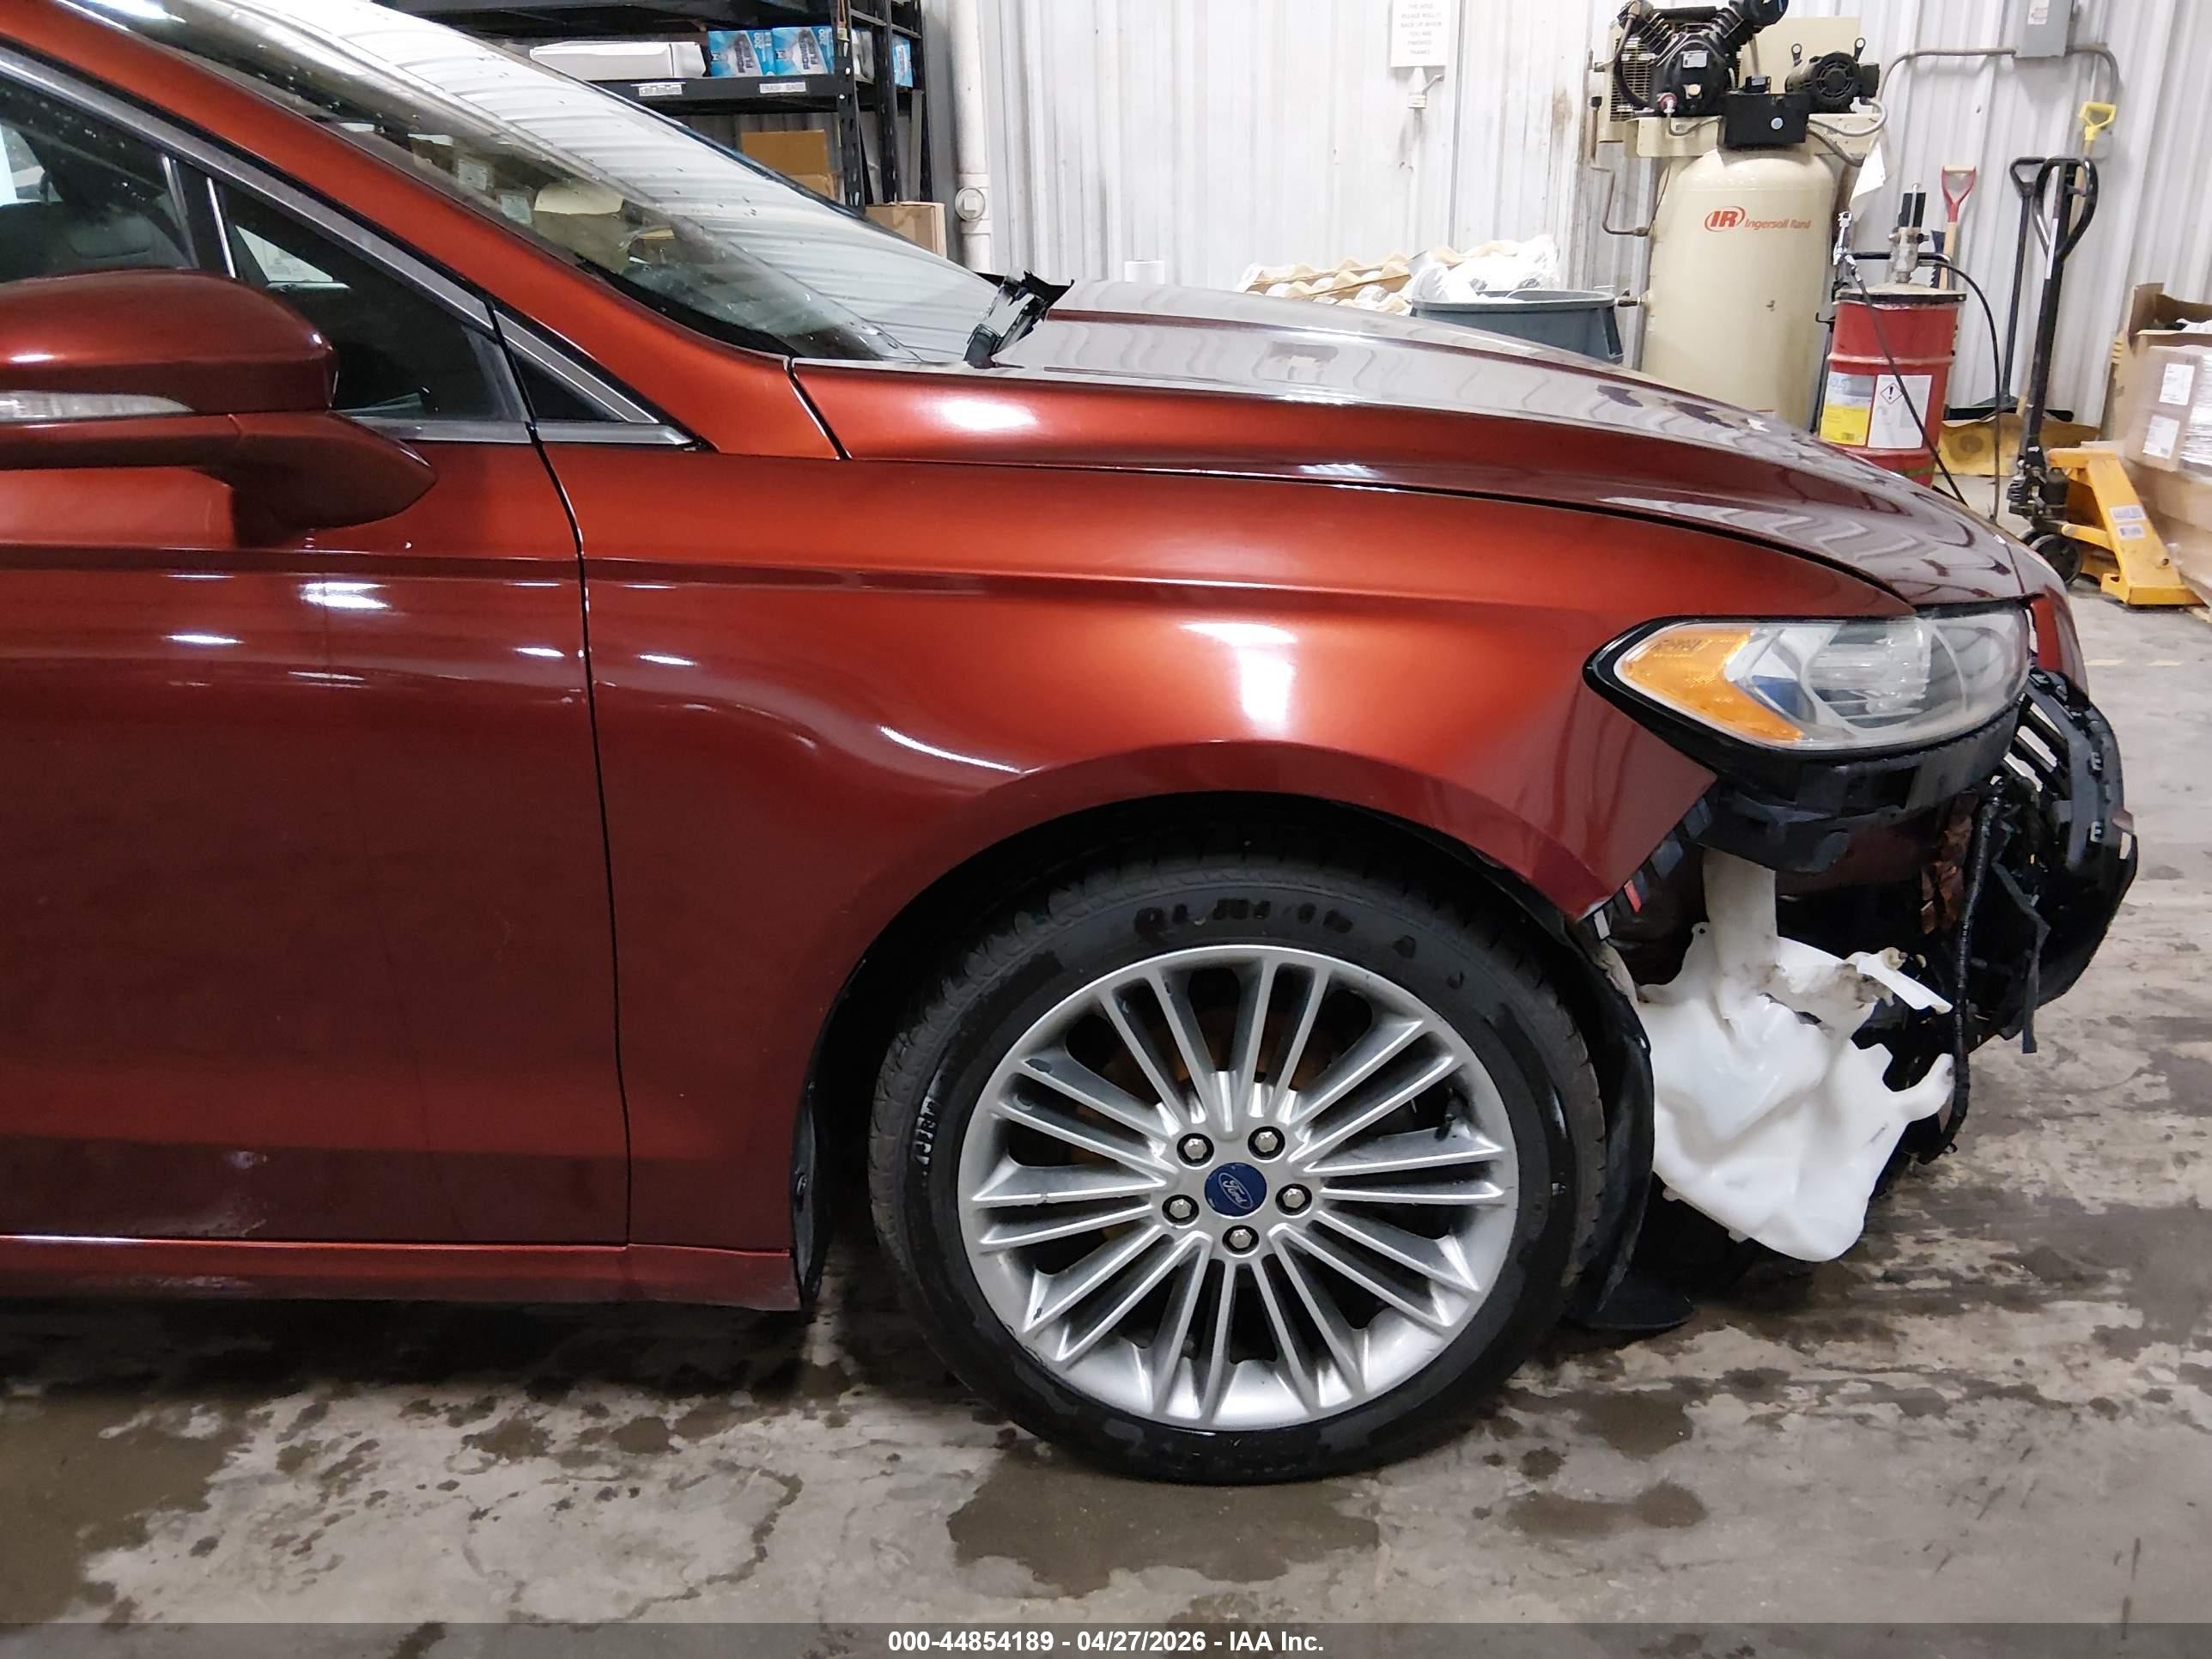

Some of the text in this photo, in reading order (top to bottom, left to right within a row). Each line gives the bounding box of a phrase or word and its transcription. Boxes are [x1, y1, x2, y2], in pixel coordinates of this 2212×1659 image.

[1711, 210, 1739, 228] IR
[1744, 218, 1812, 230] Ingersoll Rand
[1222, 1180, 1248, 1204] Ford
